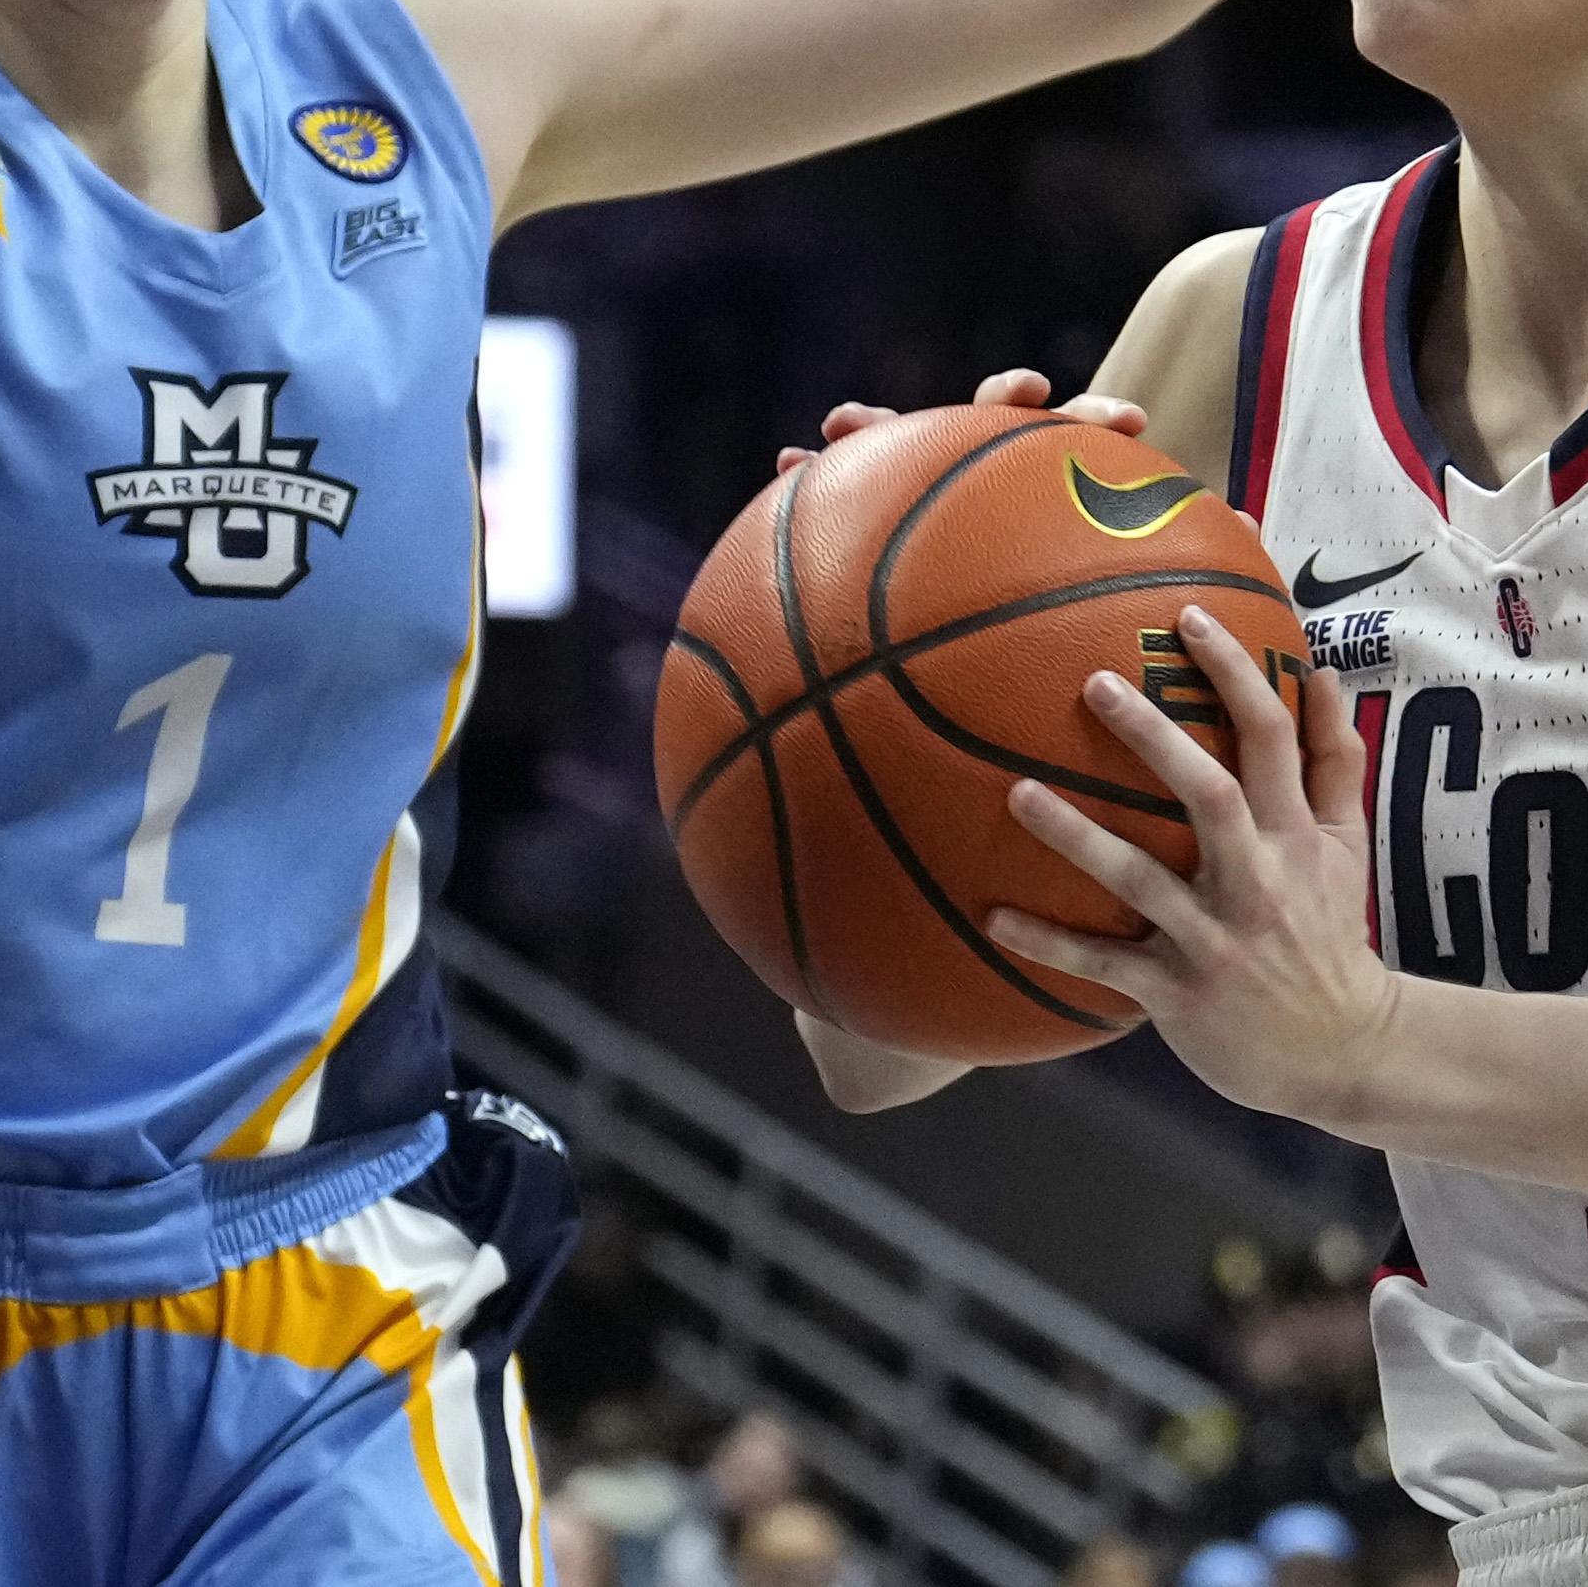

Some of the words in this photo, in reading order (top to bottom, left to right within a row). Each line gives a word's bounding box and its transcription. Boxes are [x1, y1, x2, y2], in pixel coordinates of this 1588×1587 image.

[341, 215, 420, 252] EAST
[345, 199, 400, 233] BIG
[112, 474, 337, 514] MARQUETTE
[1303, 616, 1335, 648] BE
[1342, 610, 1395, 640] THE
[1311, 634, 1392, 672] HANGE
[95, 653, 234, 947] 1
